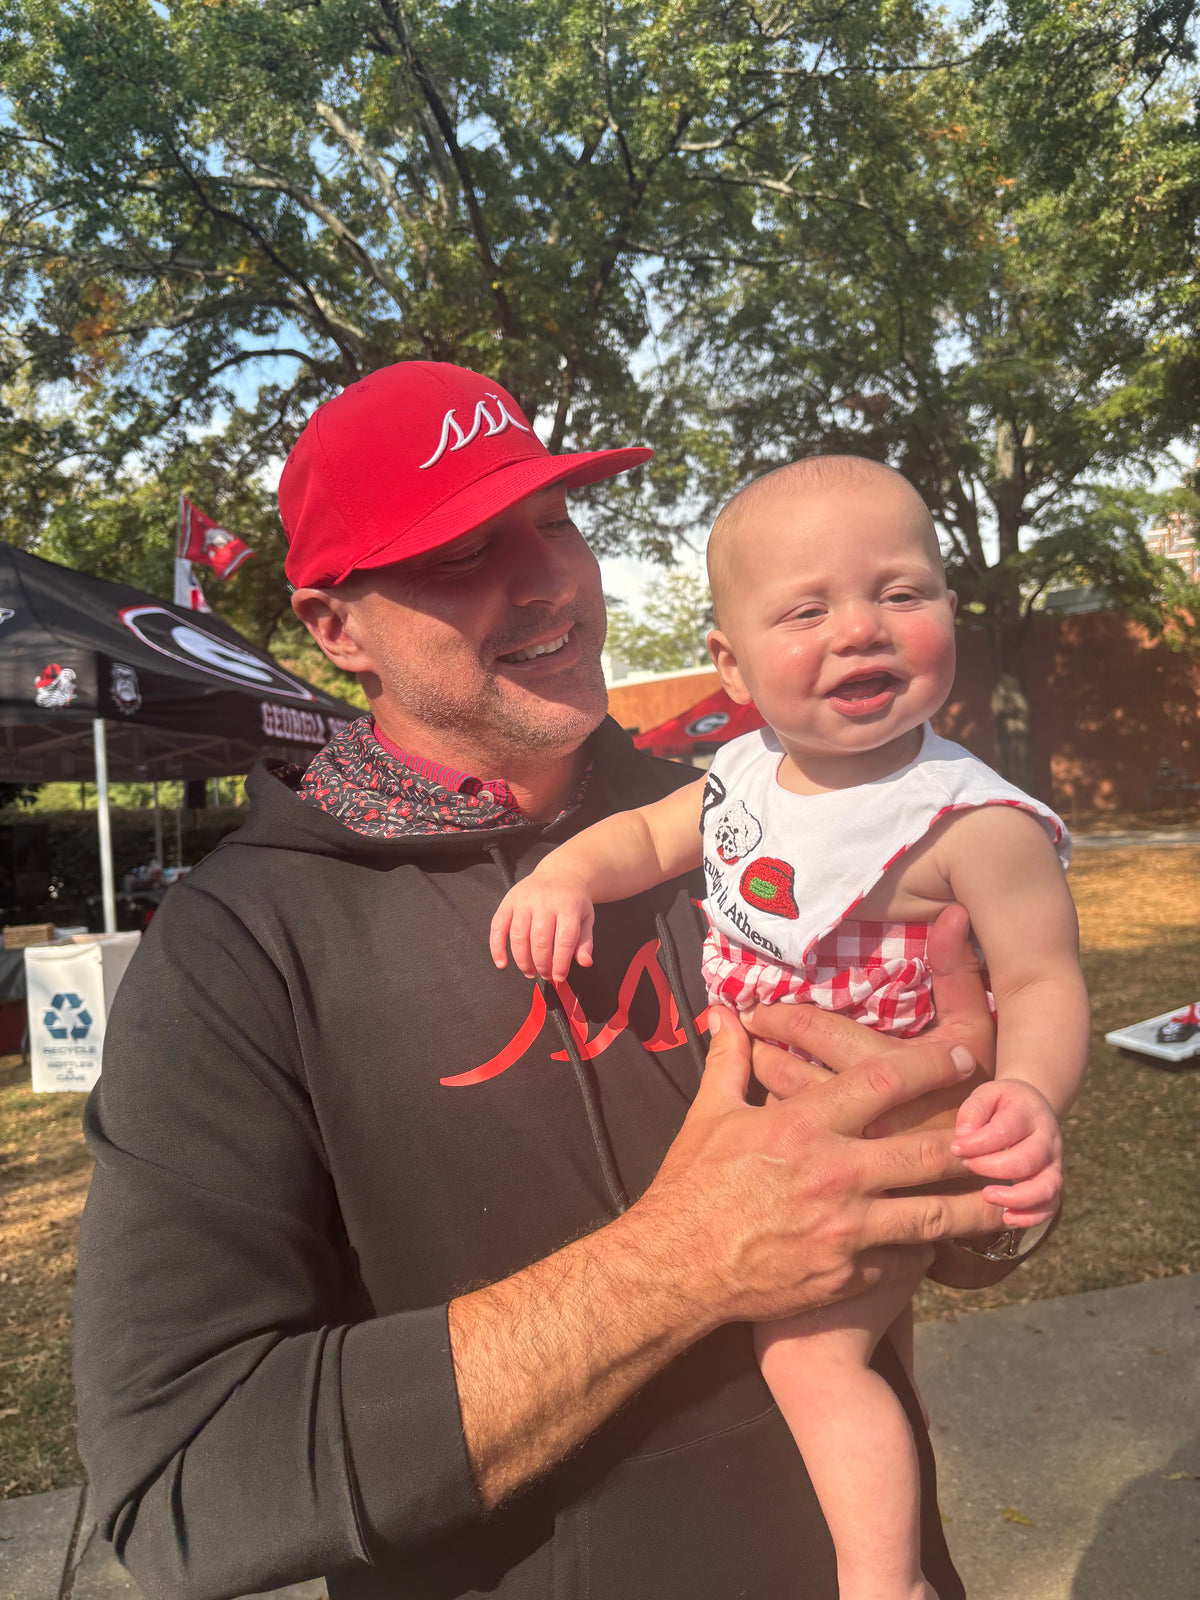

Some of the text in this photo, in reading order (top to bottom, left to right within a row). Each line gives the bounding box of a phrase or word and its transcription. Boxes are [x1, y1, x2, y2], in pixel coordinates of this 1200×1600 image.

[261, 702, 327, 744] GEORGIA
[723, 902, 783, 961] Athens
[43, 1045, 97, 1054] RECYCLE
